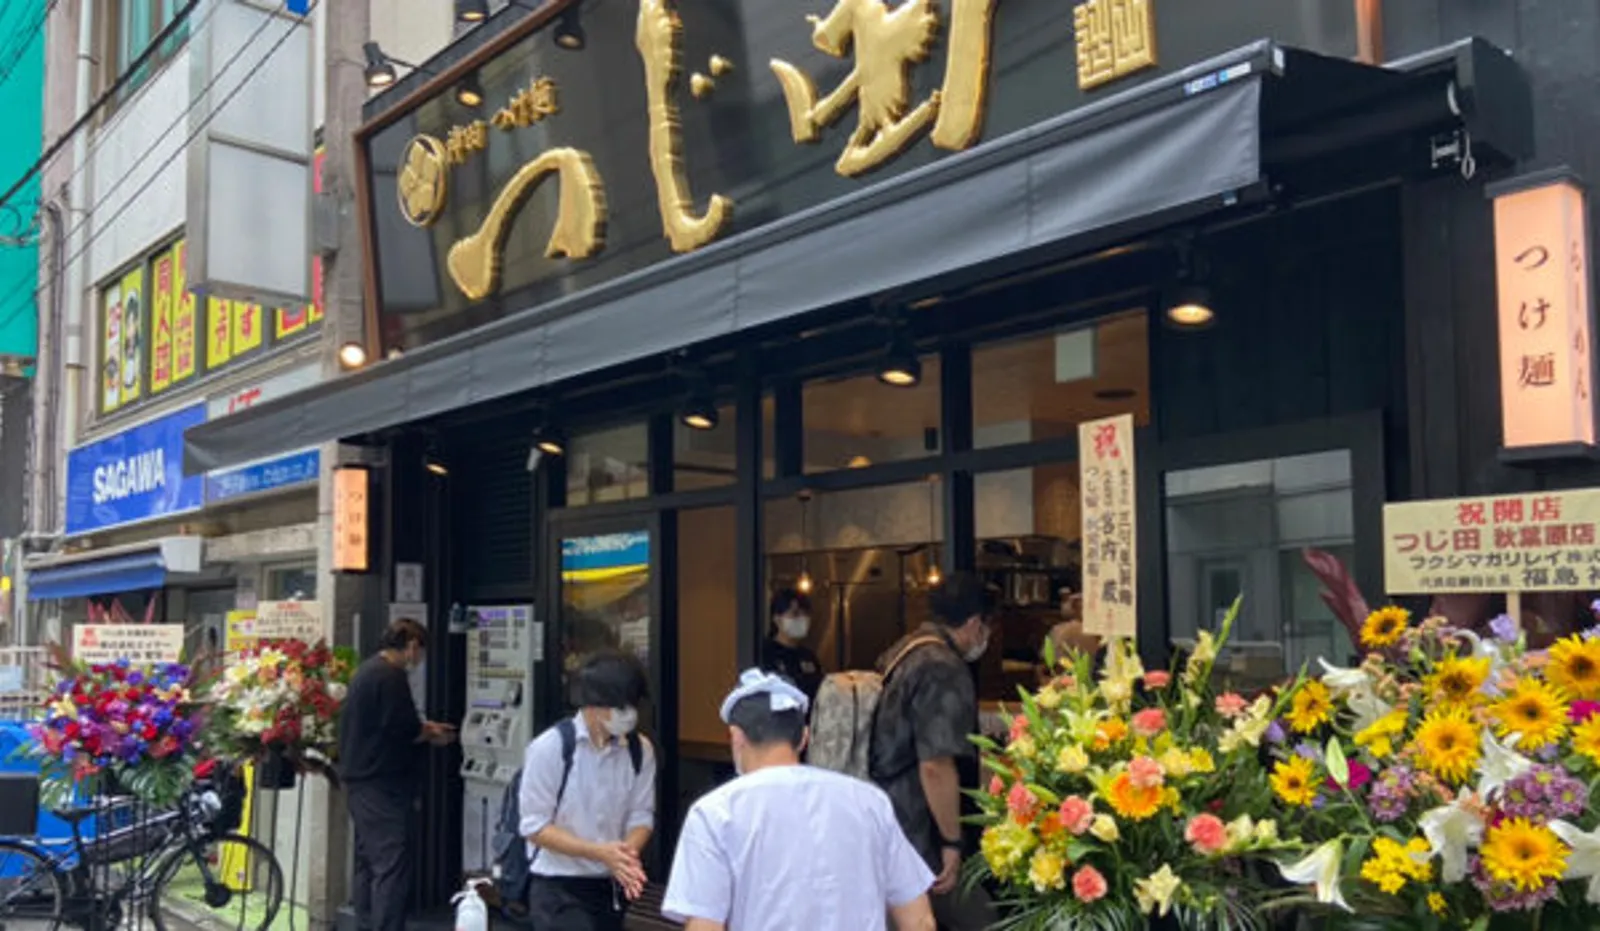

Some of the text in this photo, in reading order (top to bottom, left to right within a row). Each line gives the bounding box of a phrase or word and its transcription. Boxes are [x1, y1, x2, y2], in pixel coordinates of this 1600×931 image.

[1513, 245, 1556, 388] つけ麺
[1570, 241, 1588, 400] らーめん
[1093, 423, 1121, 459] 祝
[92, 448, 165, 504] SAGAWA
[1456, 497, 1562, 525] 祝開店
[1393, 522, 1596, 554] つじ田 秋葉原店
